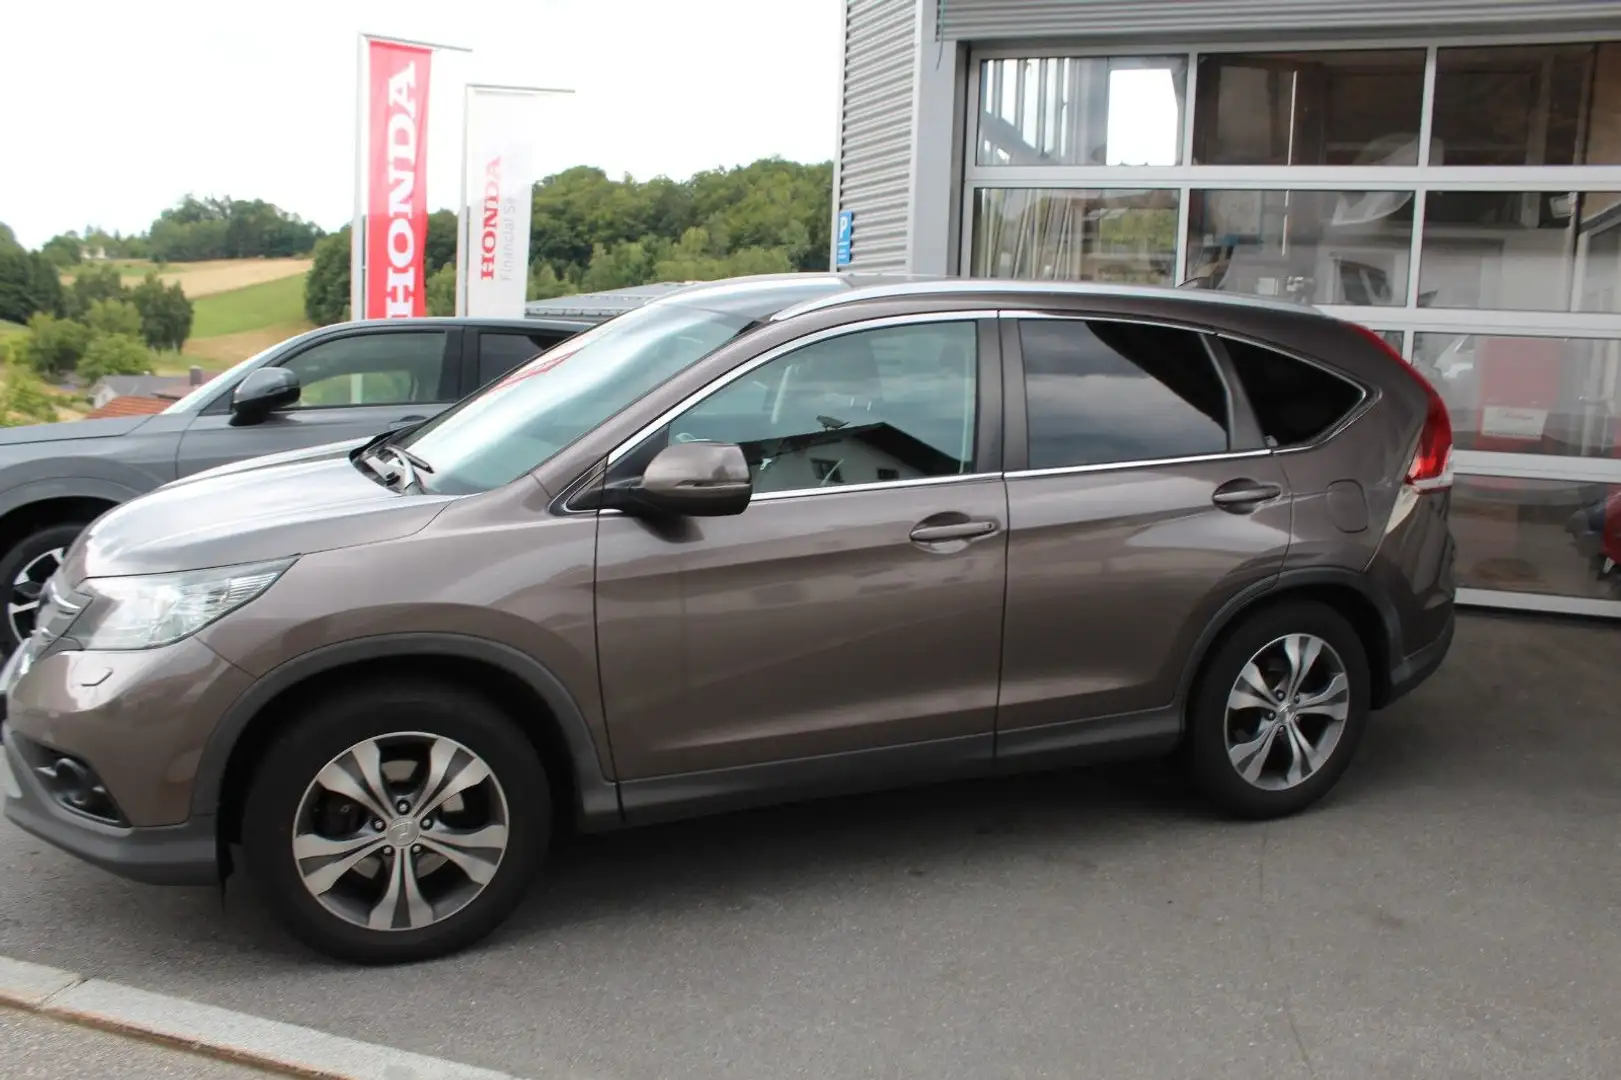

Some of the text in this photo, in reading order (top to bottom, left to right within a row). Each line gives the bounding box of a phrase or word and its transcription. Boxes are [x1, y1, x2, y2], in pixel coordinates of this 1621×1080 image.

[386, 61, 416, 318] HONDA
[480, 156, 501, 280] HONDA
[501, 219, 516, 281] Financial
